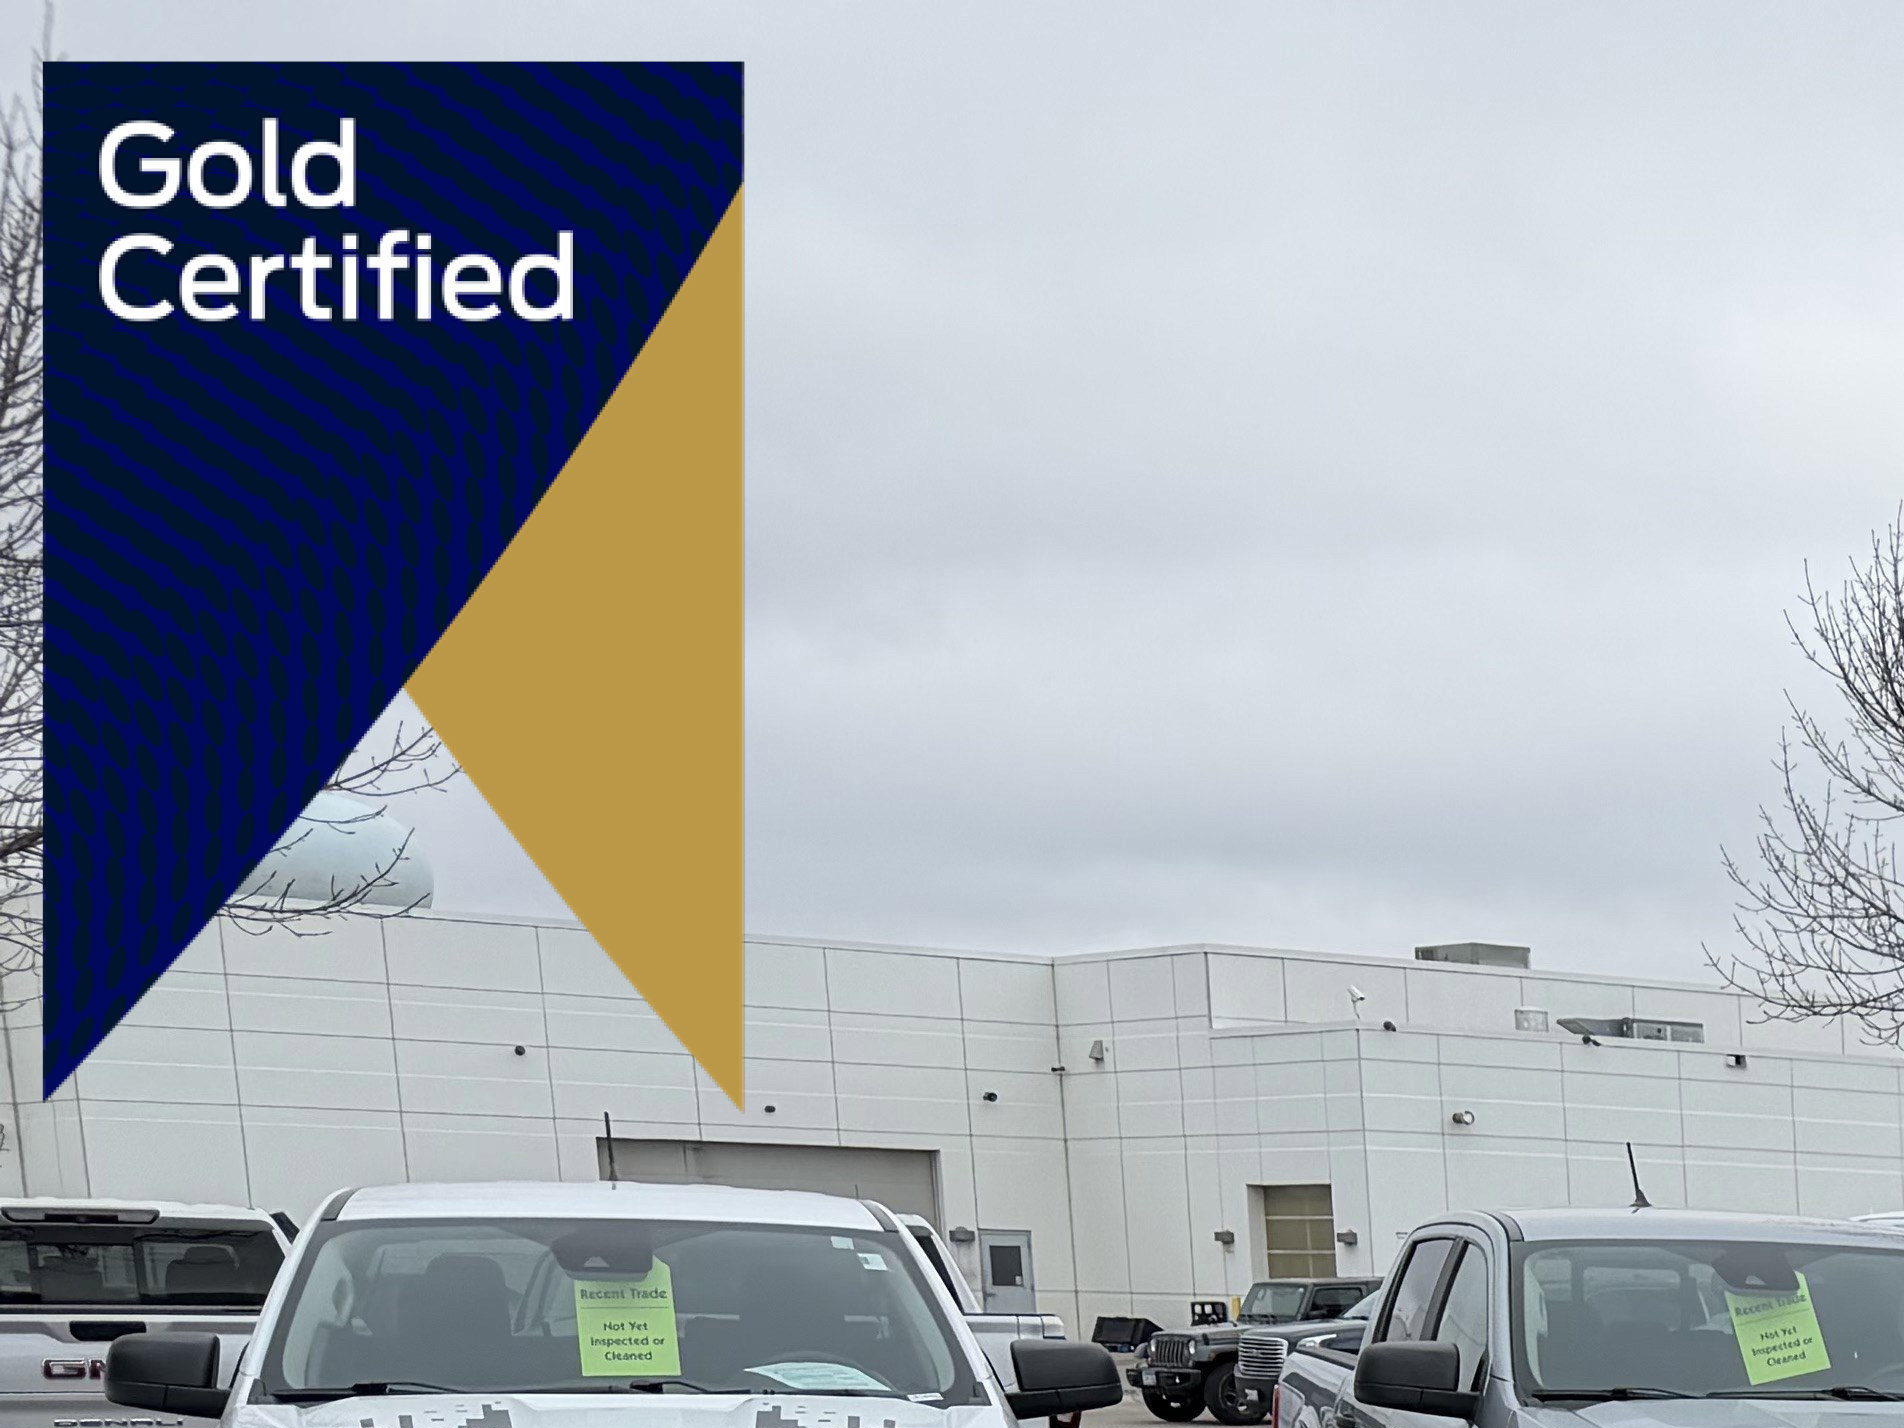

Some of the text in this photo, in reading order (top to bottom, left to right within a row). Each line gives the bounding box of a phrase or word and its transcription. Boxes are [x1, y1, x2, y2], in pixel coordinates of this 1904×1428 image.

[580, 1287, 667, 1300] Recent Trade
[603, 1321, 648, 1332] Not Yet
[590, 1336, 665, 1347] Inspected or
[1760, 1330, 1780, 1342] Not
[1751, 1338, 1801, 1357] Inspected
[604, 1351, 653, 1361] Cleaned
[1766, 1350, 1807, 1366] Cleaned
